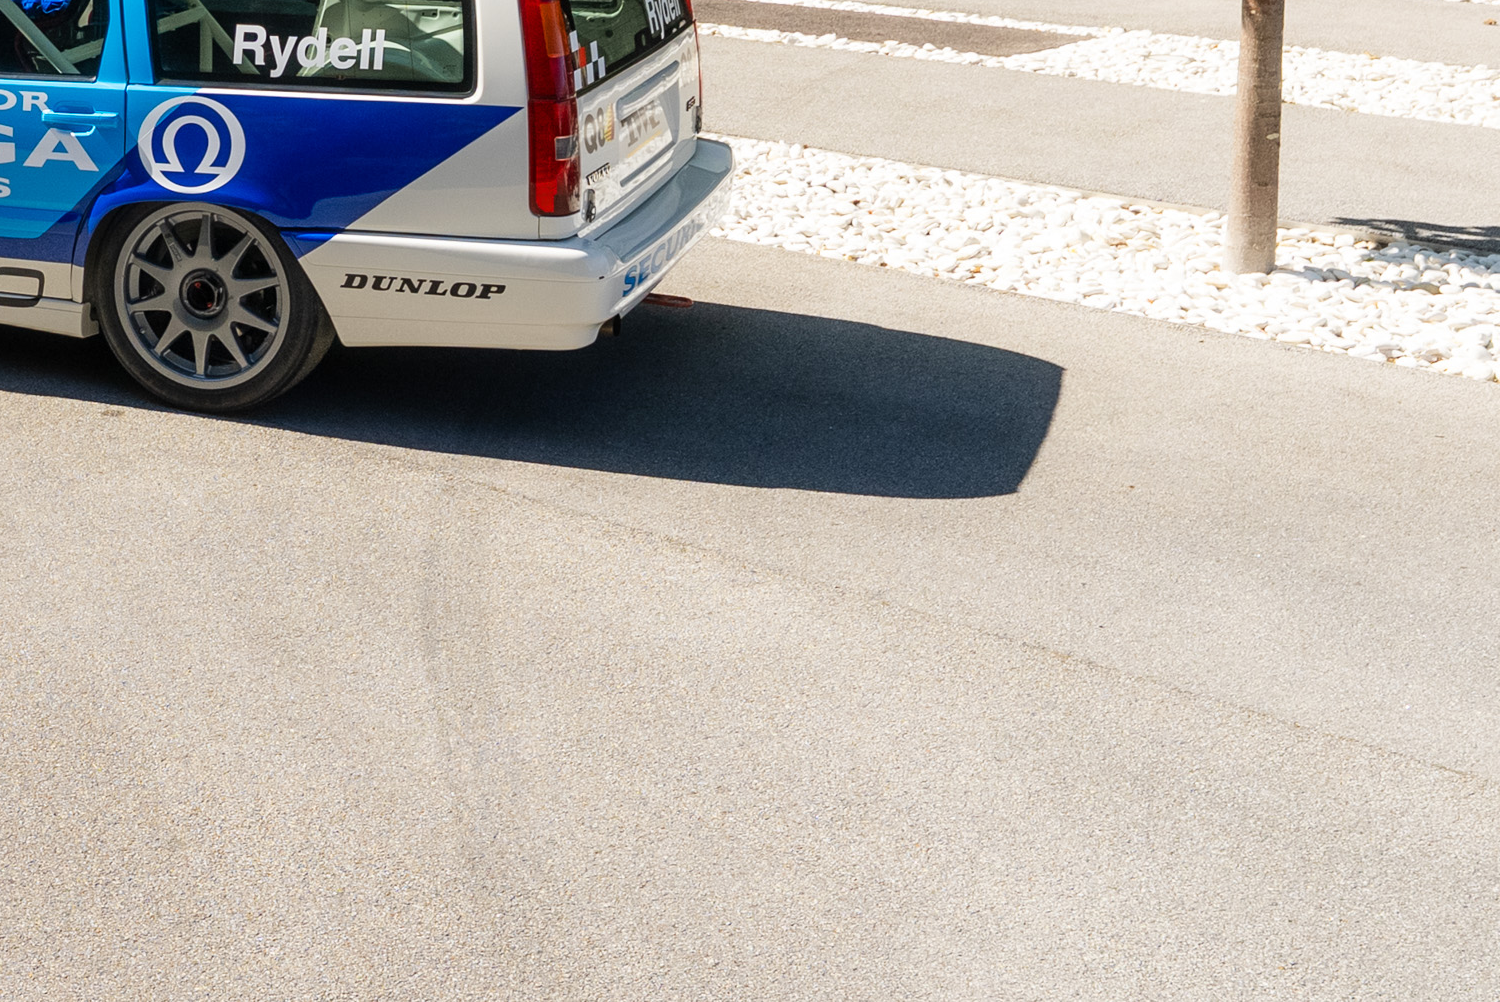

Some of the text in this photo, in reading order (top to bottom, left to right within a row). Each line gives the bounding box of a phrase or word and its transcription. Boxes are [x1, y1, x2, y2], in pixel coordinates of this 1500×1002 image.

[232, 24, 386, 78] Rydell
[584, 107, 606, 154] Q8
[340, 273, 506, 300] DUNLOP
